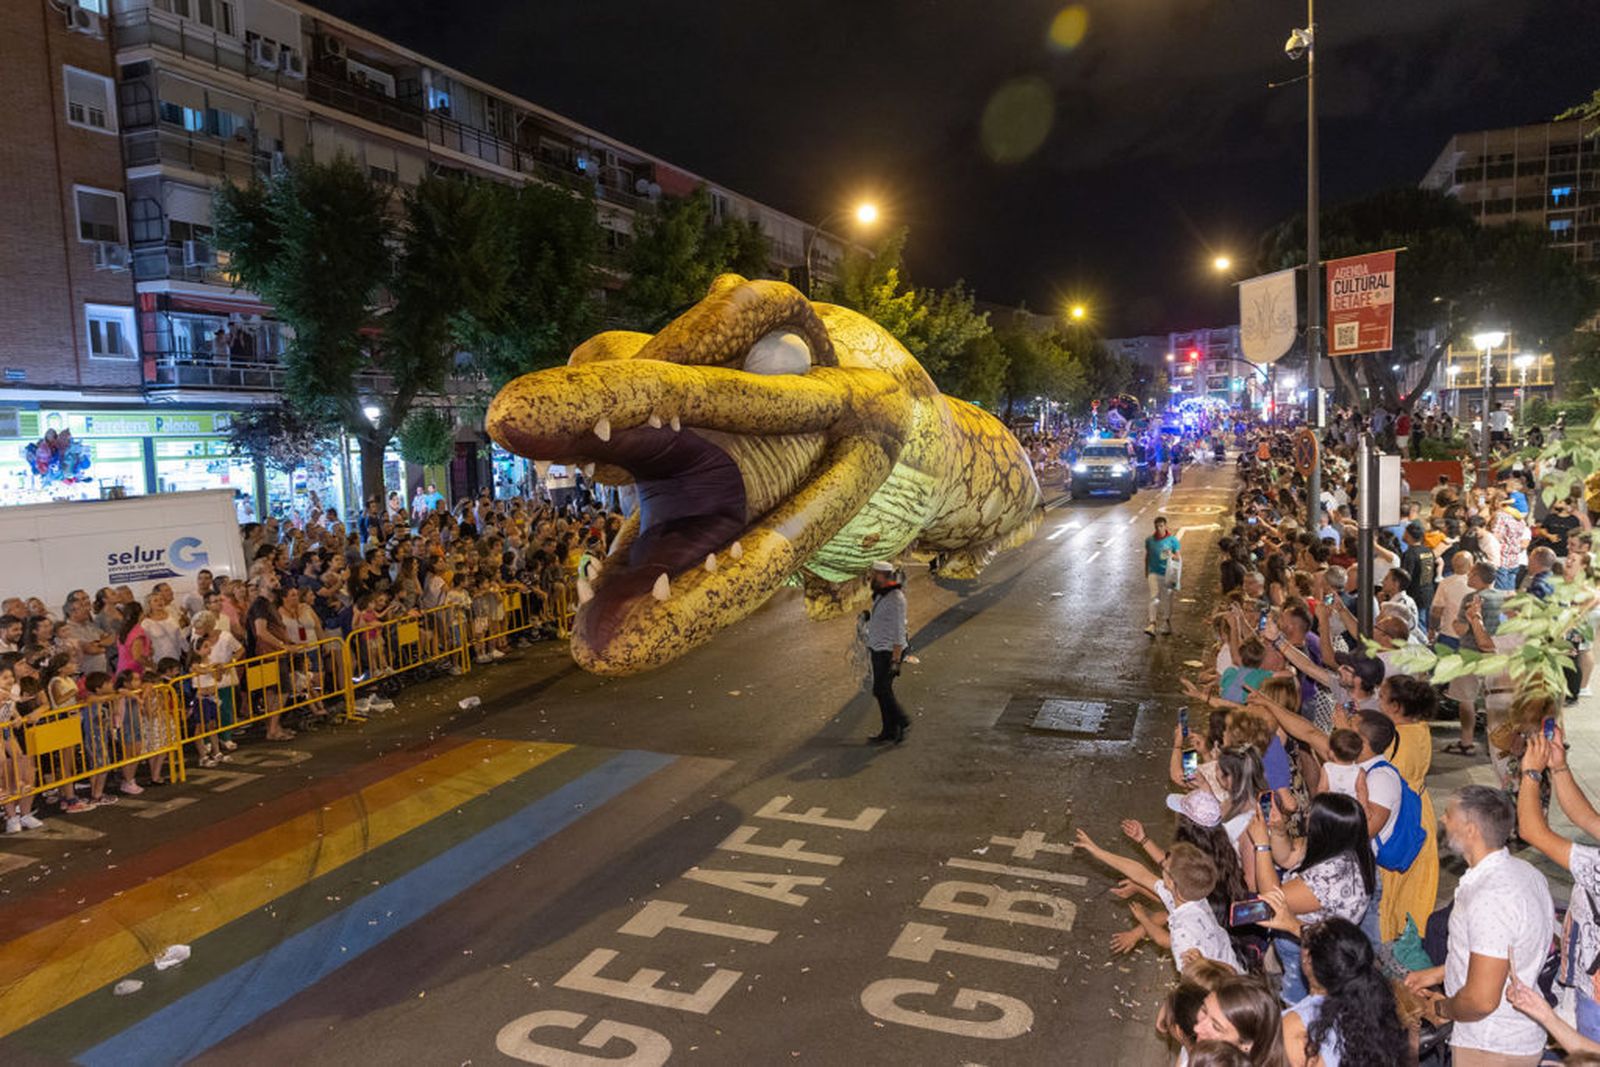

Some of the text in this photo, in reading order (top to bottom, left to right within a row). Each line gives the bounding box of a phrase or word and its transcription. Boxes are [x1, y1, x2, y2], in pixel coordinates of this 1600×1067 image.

[1334, 273, 1390, 295] CULTURAL
[1334, 291, 1375, 310] GETAFE
[496, 795, 887, 1067] GETAFE
[860, 829, 1089, 1067] GTBI+
